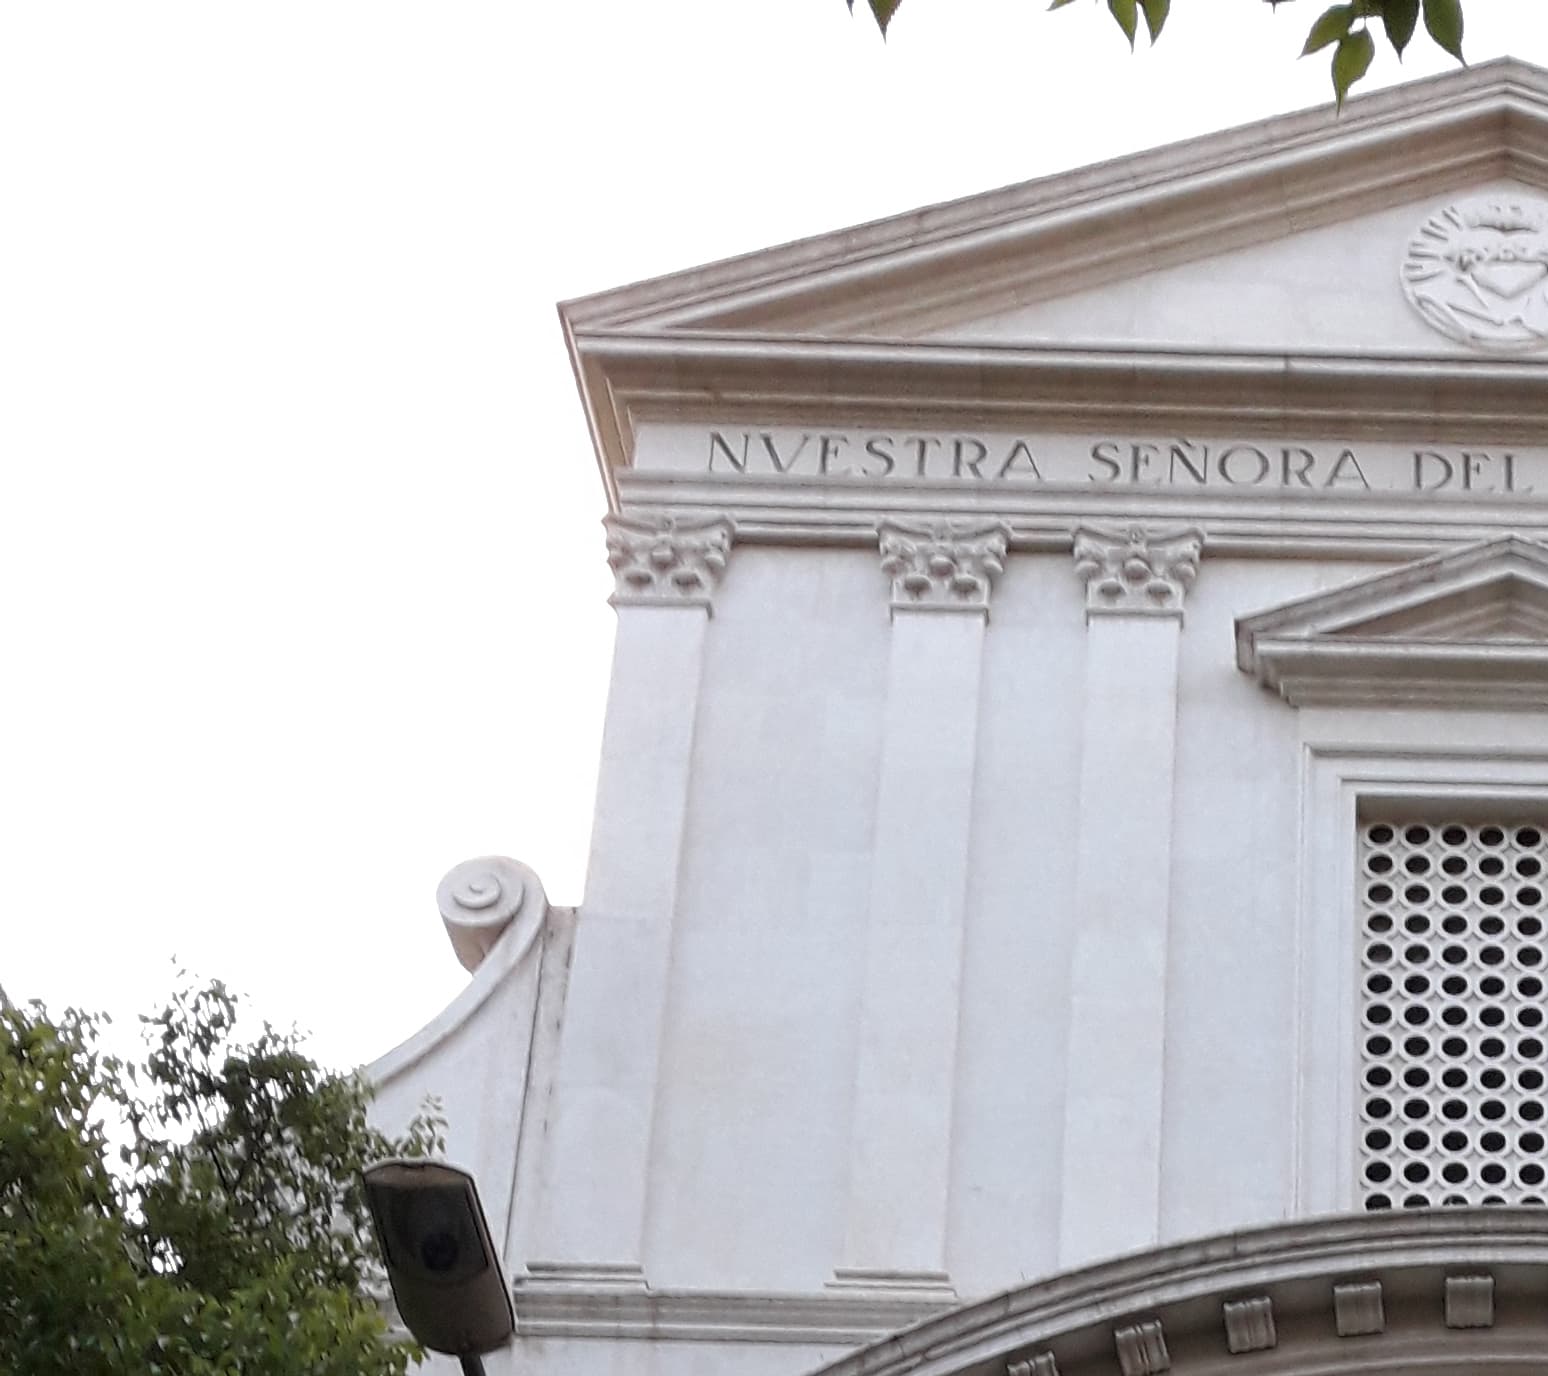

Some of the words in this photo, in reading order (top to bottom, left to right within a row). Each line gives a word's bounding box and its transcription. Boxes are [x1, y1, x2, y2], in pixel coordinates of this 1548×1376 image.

[708, 431, 1041, 480] NVESTRA
[1088, 437, 1371, 490] SEÑORA
[1412, 451, 1533, 494] DEL
